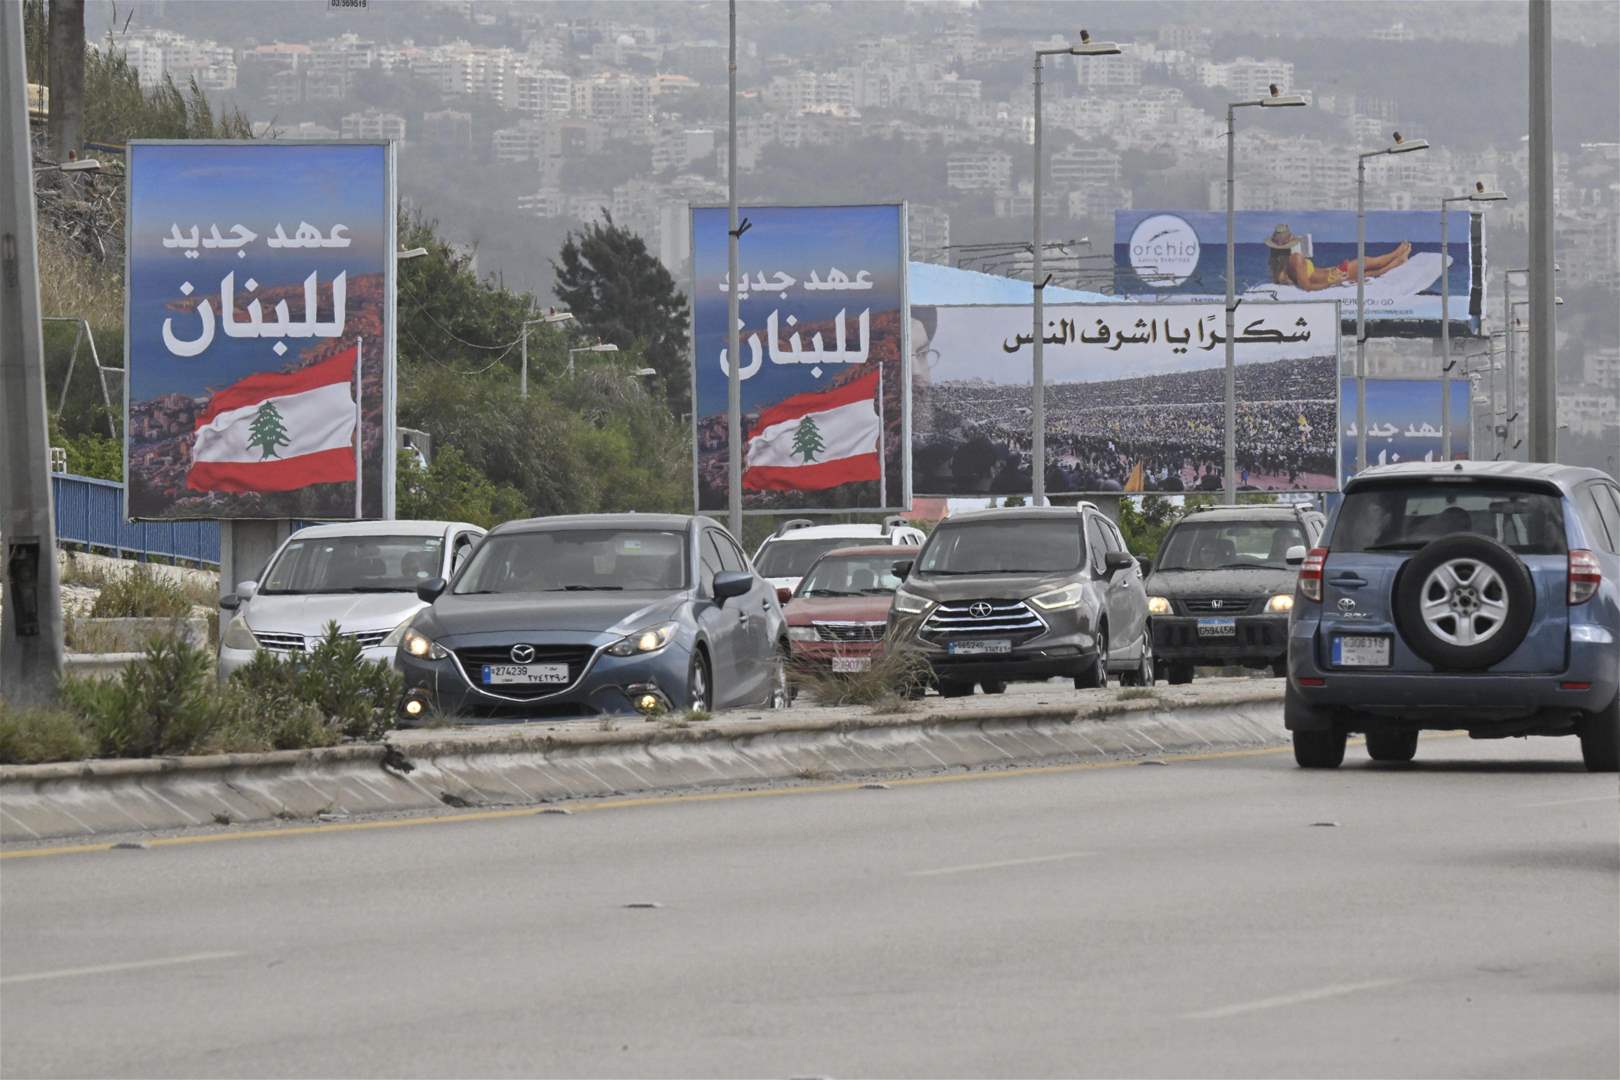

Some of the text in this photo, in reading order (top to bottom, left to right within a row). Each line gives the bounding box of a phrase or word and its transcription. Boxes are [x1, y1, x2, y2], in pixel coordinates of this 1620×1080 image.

[162, 220, 352, 259] عهد جديد
[1133, 241, 1197, 256] orchid
[803, 267, 874, 290] عهد
[162, 270, 347, 357] للبنان
[720, 307, 870, 381] للبنان
[1080, 318, 1157, 351] اشرف
[1165, 318, 1191, 354] يا
[495, 666, 528, 676] 274239
